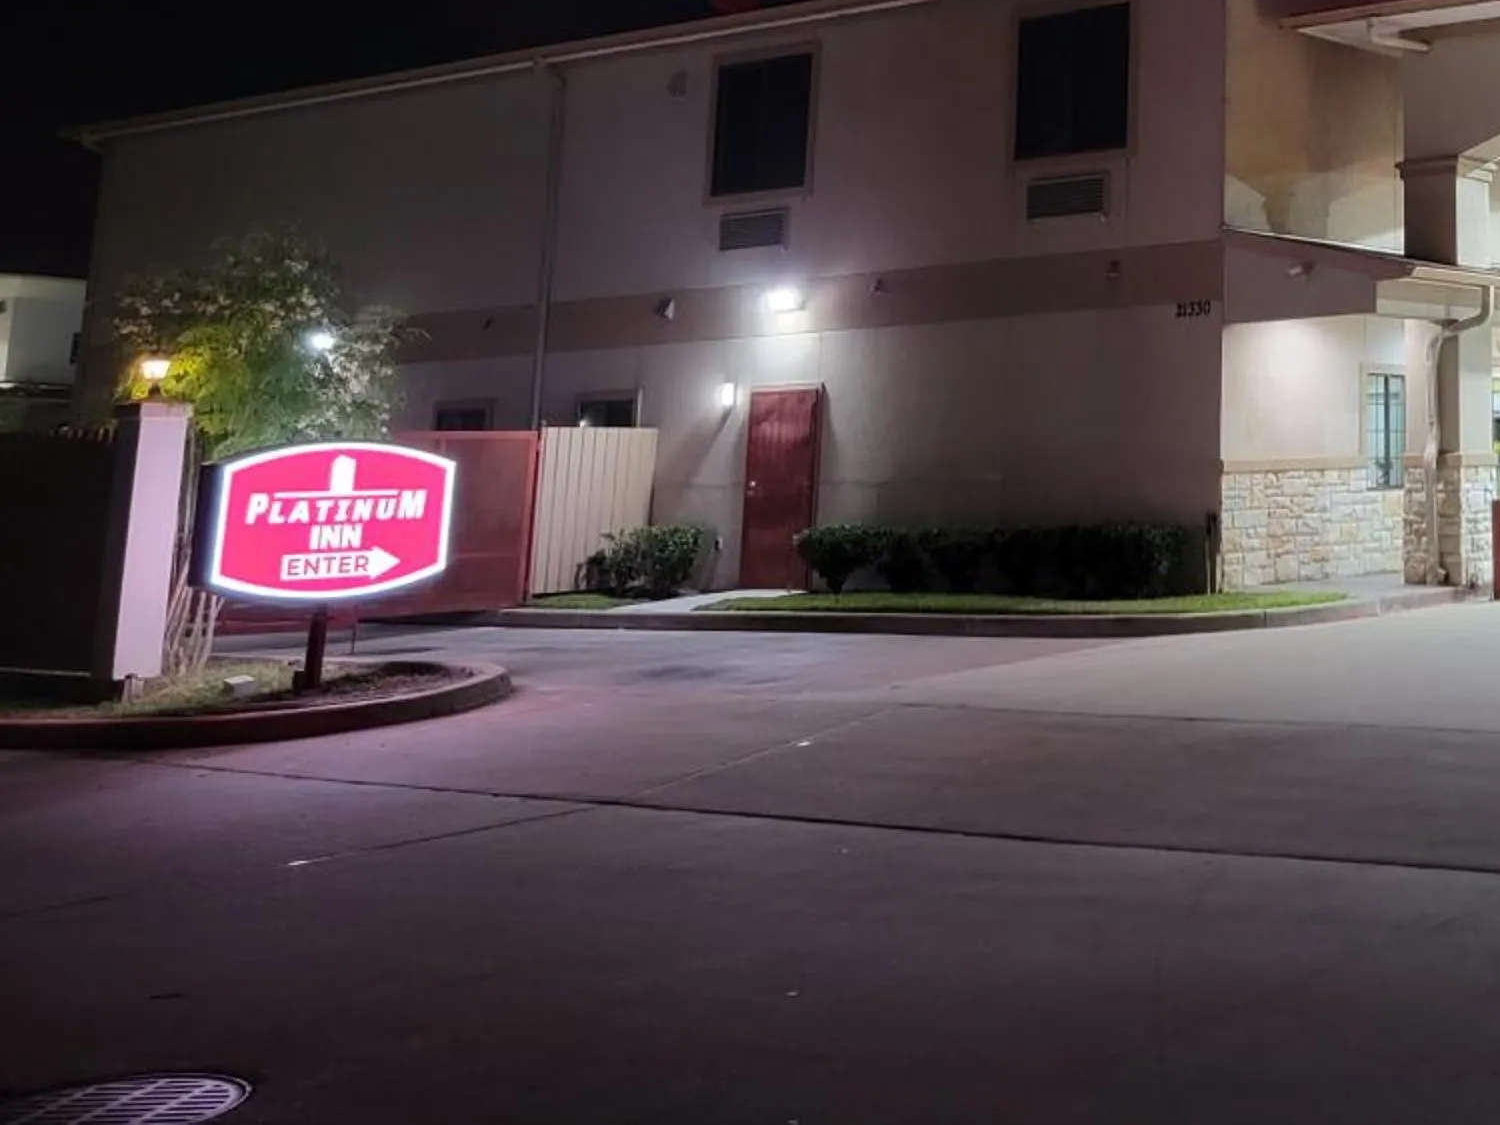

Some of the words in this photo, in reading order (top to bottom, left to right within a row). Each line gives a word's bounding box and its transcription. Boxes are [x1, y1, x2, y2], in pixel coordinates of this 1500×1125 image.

[245, 489, 428, 524] PLATINUM
[309, 522, 363, 550] INN
[286, 554, 370, 577] ENTER
